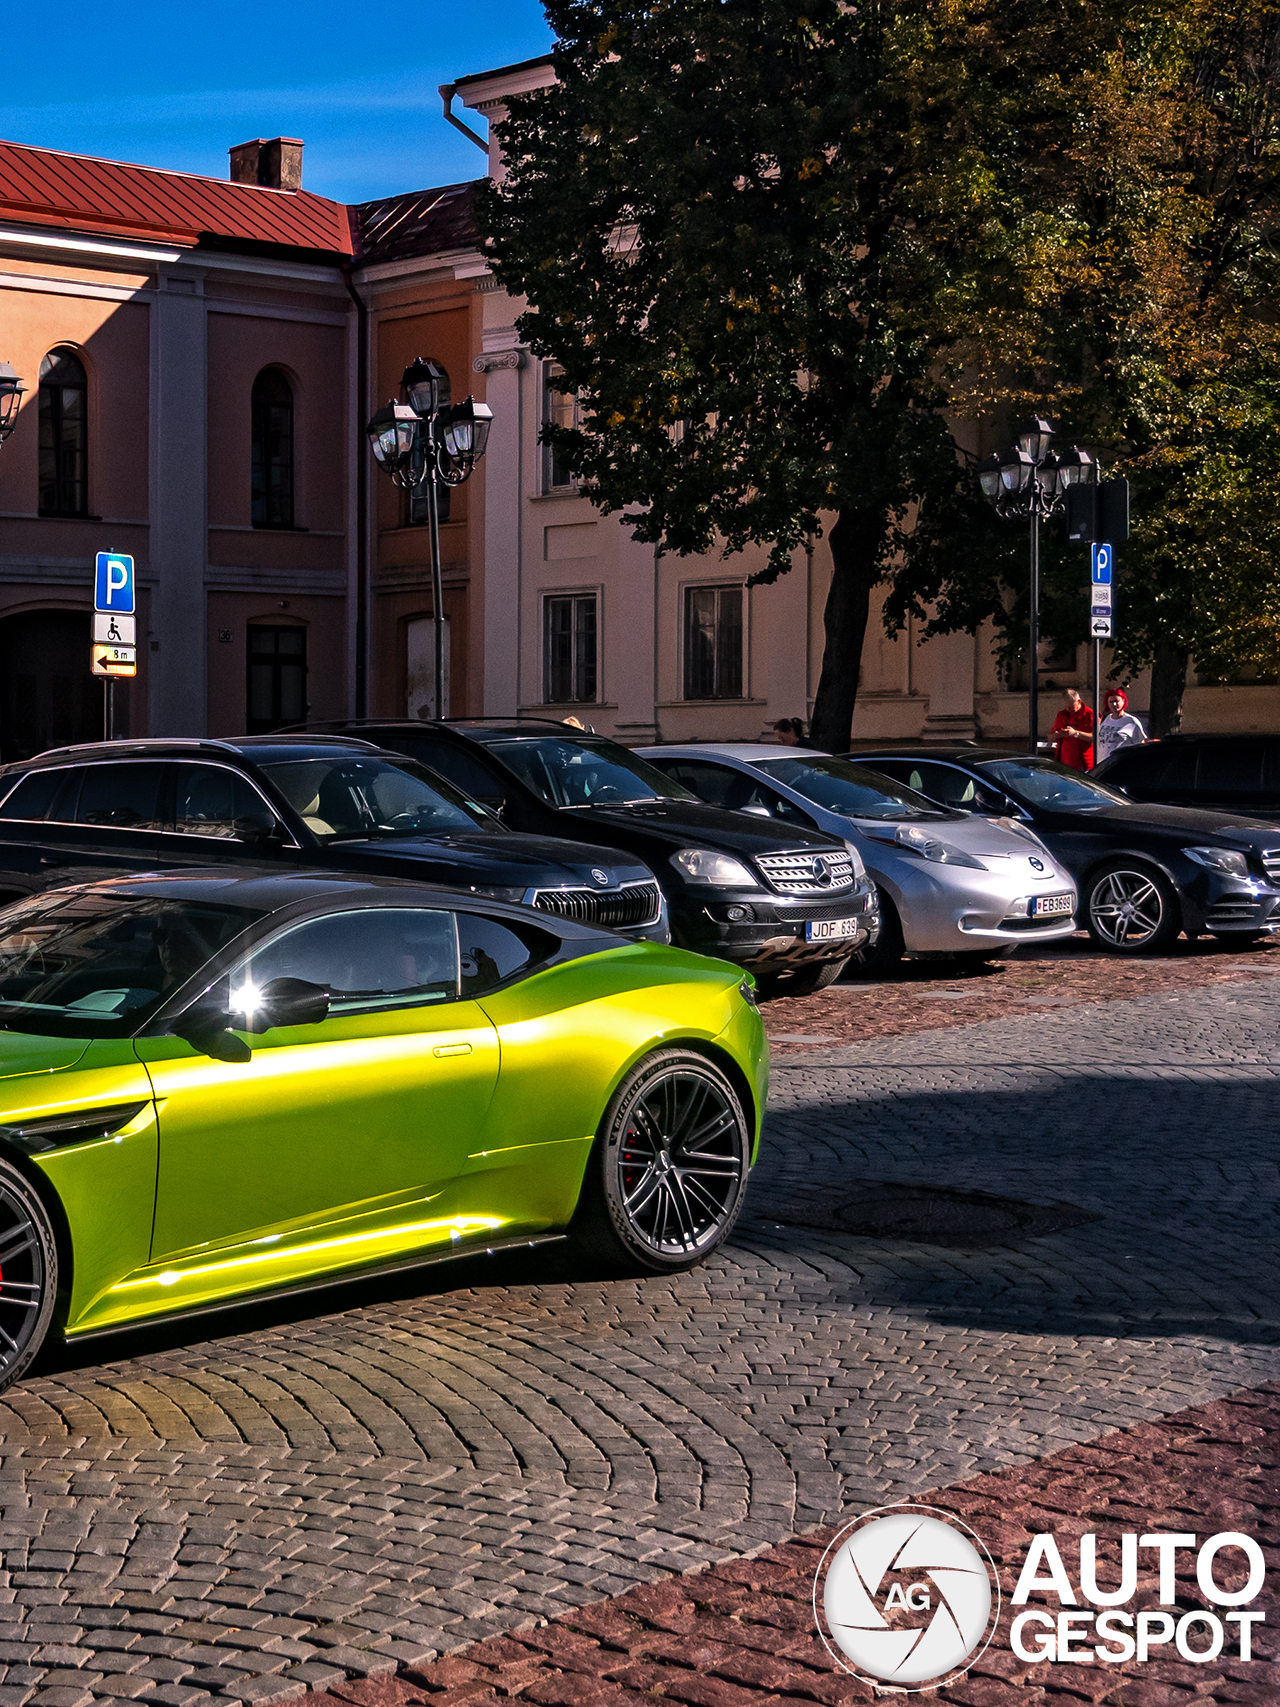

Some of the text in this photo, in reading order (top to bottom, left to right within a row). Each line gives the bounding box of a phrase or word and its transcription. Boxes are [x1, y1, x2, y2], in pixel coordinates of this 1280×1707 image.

[1097, 549, 1108, 579] P
[106, 560, 128, 605] P
[113, 649, 128, 660] 8 m
[1042, 896, 1071, 912] EB3699
[812, 919, 856, 938] JDF 639
[614, 1077, 644, 1129] MICHELIN
